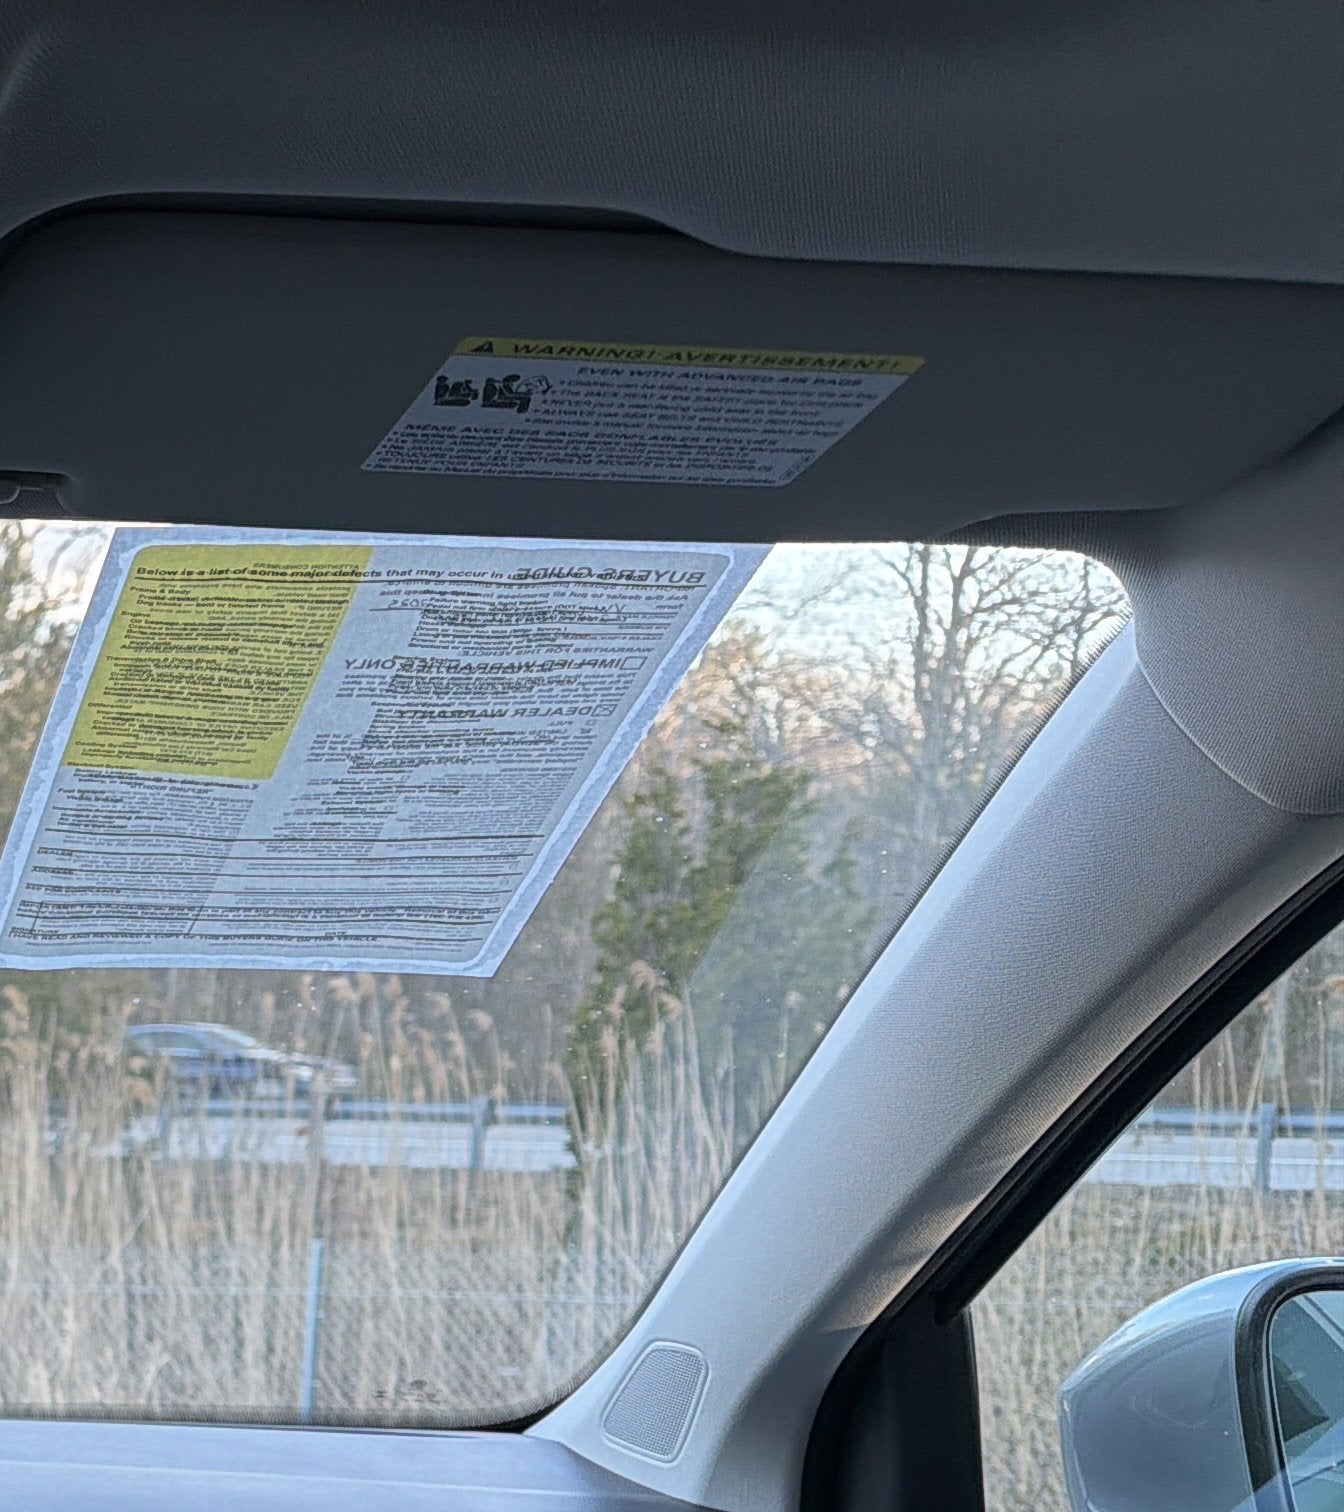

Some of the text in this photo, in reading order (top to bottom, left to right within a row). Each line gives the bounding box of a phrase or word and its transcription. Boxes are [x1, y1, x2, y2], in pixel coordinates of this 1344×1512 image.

[514, 344, 900, 369] WARNING! AVERTISSEMENT!
[136, 566, 177, 577] Below
[332, 568, 381, 578] defects
[386, 568, 412, 577] that
[415, 569, 445, 579] may
